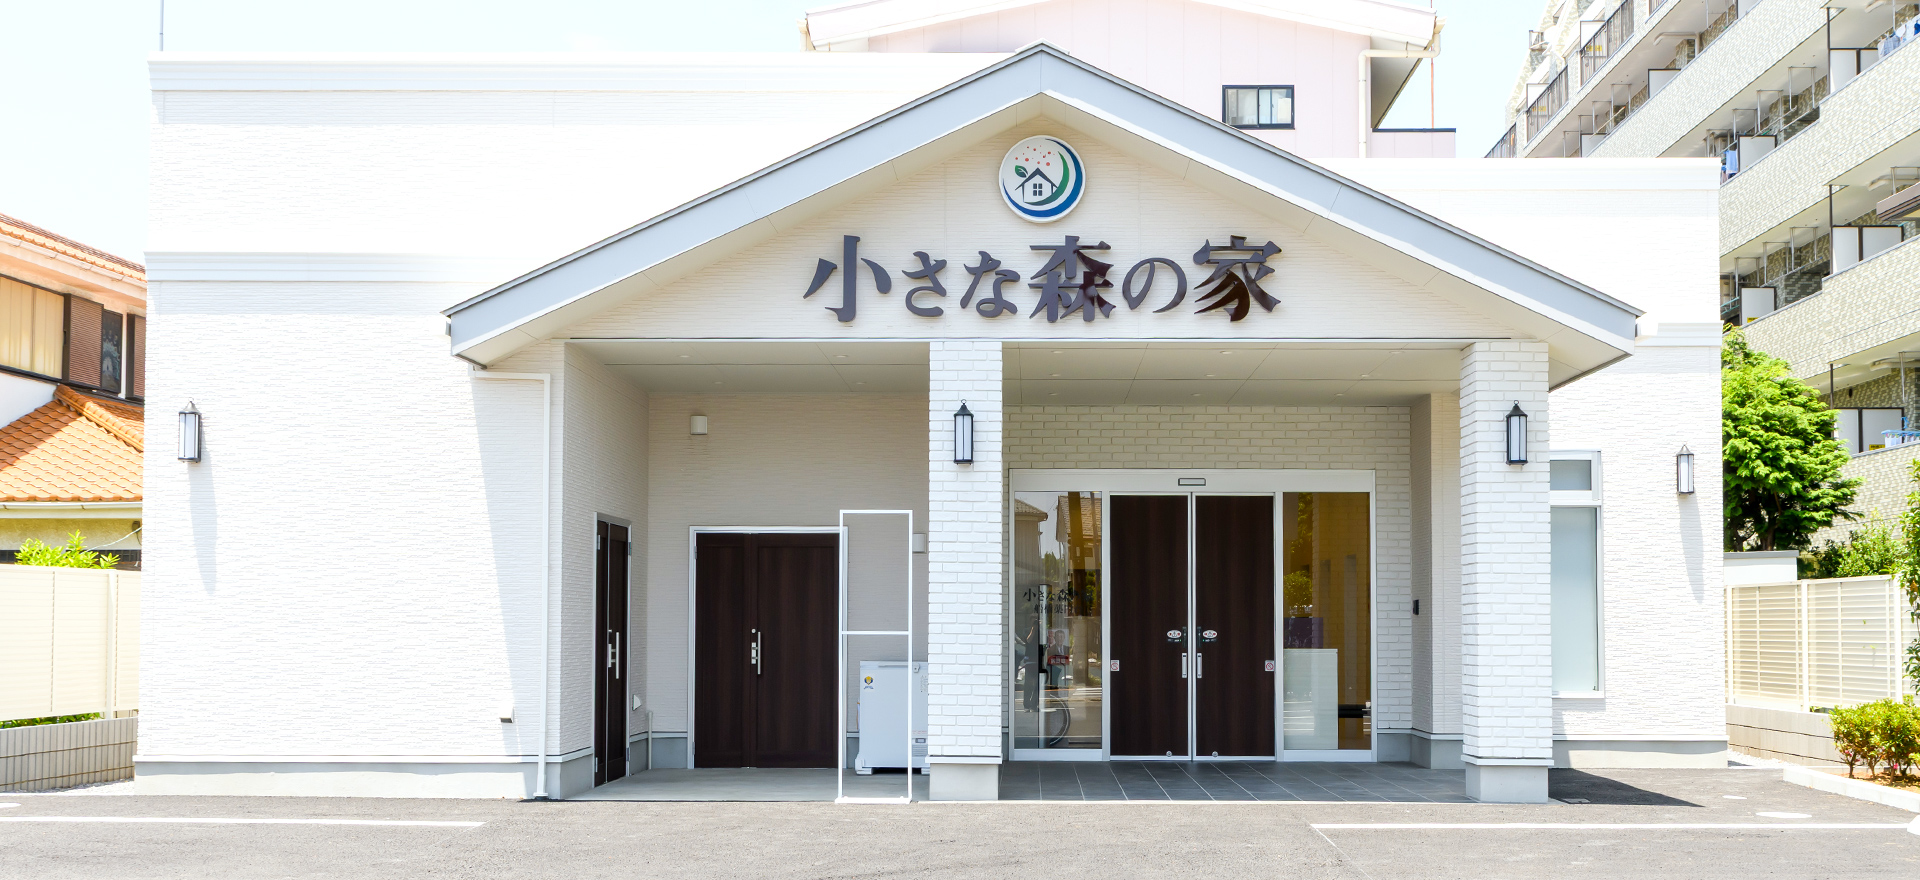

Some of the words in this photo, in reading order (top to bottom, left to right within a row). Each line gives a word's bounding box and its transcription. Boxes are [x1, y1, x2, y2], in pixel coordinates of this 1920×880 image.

[803, 235, 1282, 322] 小さな森の家
